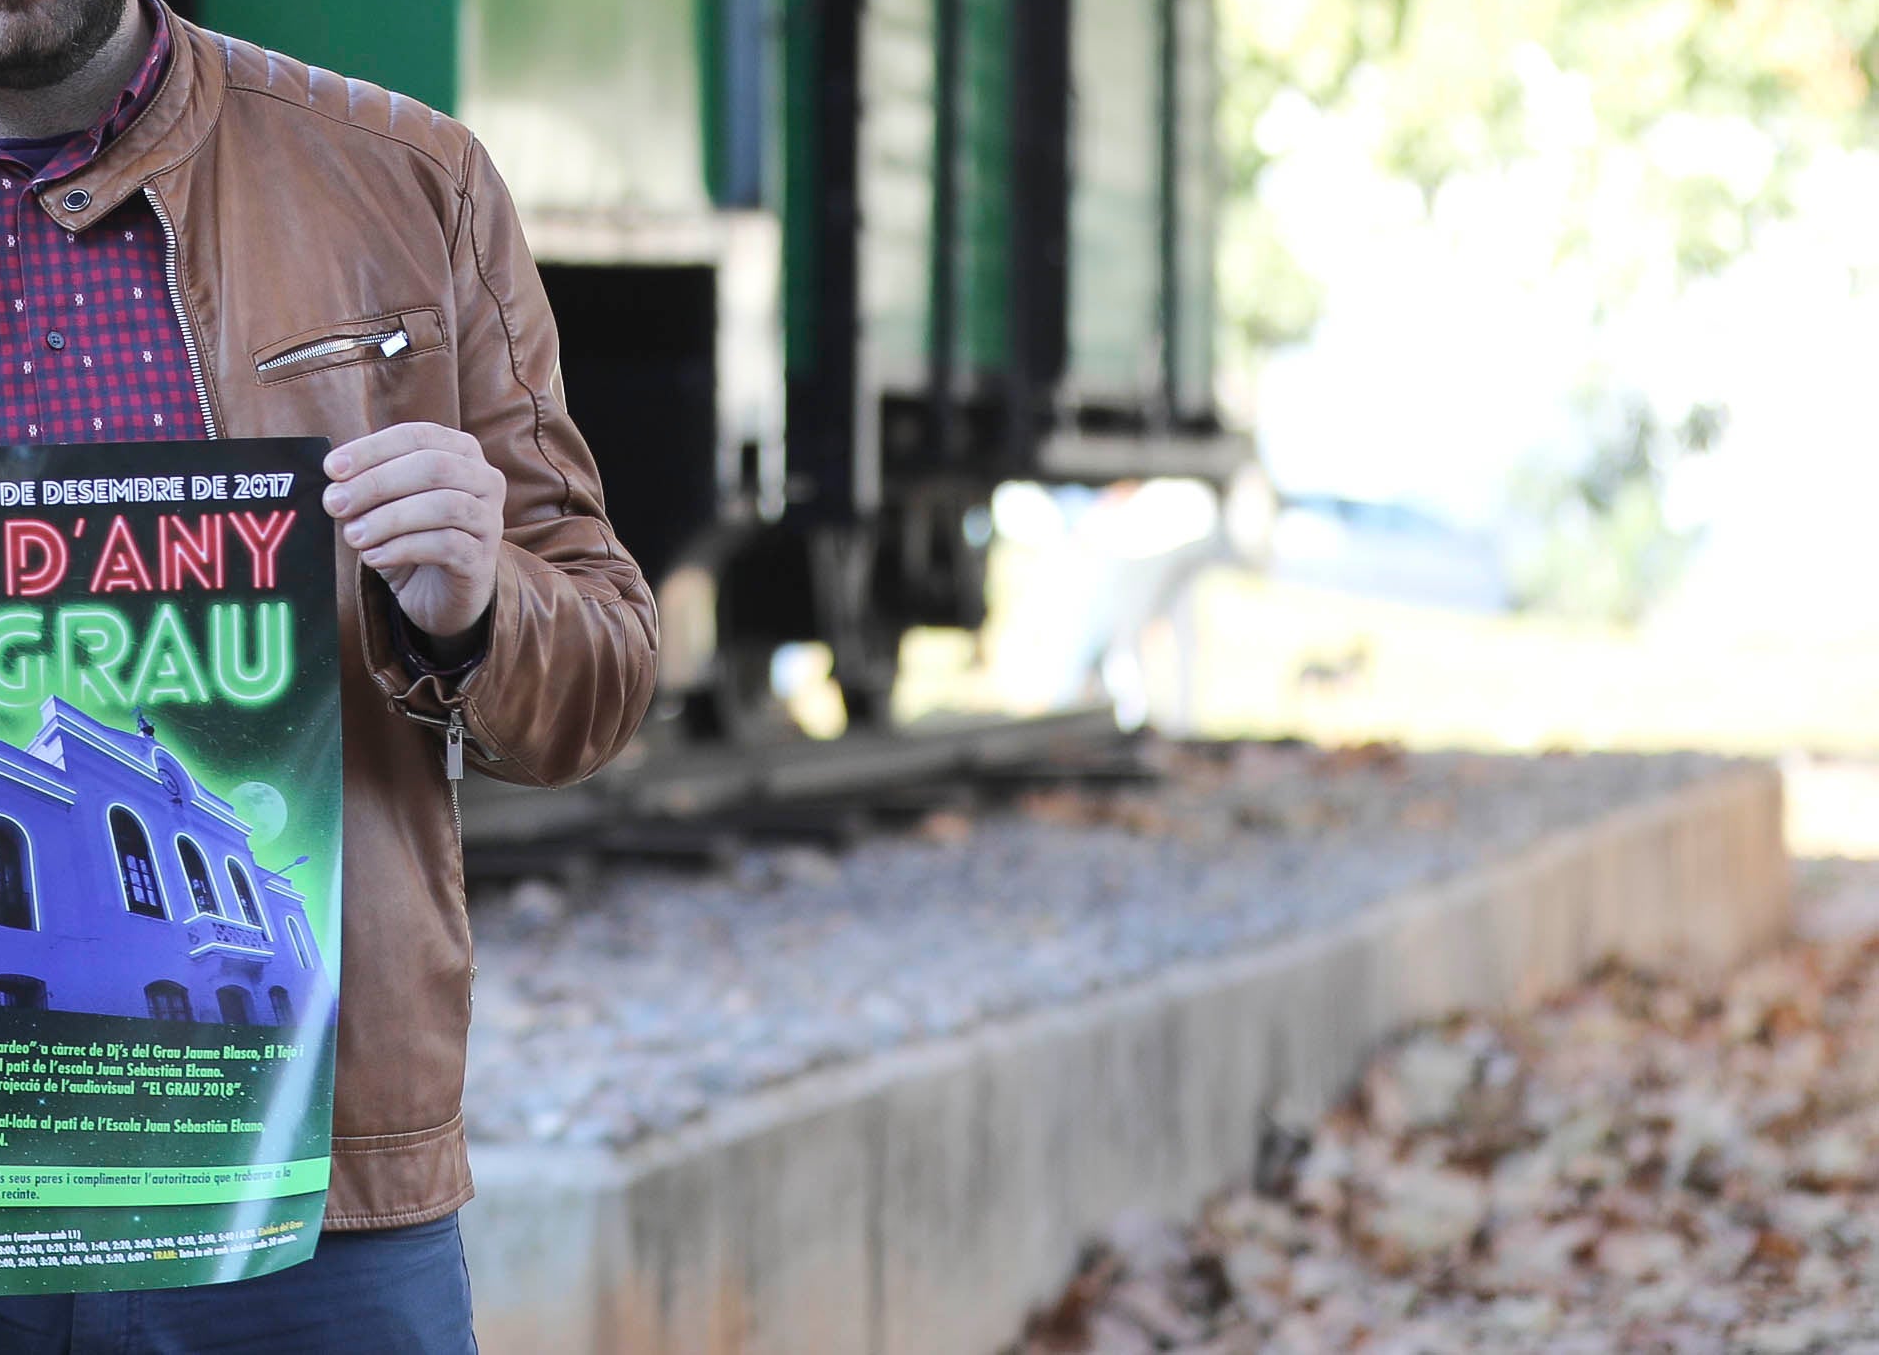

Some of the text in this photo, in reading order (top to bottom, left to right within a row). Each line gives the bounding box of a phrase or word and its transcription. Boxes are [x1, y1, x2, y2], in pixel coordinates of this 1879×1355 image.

[41, 475, 187, 506] DESEMBRE
[190, 474, 229, 502] DE
[231, 471, 296, 500] 2017
[5, 510, 296, 598] D'ANY
[37, 1043, 50, 1056] a
[50, 1041, 88, 1058] càrrec
[87, 1041, 105, 1058] de
[130, 1043, 151, 1059] del
[151, 1044, 182, 1063] Grau
[182, 1044, 222, 1061] Jaume
[222, 1044, 262, 1062] Blasco,
[262, 1043, 276, 1060] El
[4, 1058, 31, 1077] pati
[31, 1058, 48, 1075] de
[94, 1061, 125, 1077] Juan
[125, 1062, 184, 1079] Sebastián
[184, 1063, 226, 1079] Elcano.
[42, 1076, 60, 1094] de
[164, 1080, 201, 1097] GRAU
[39, 1113, 53, 1131] al
[53, 1115, 79, 1132] pati
[79, 1115, 96, 1132] de
[142, 1117, 172, 1134] Juan
[172, 1118, 229, 1134] Sebastián
[0, 1186, 41, 1201] recinte.
